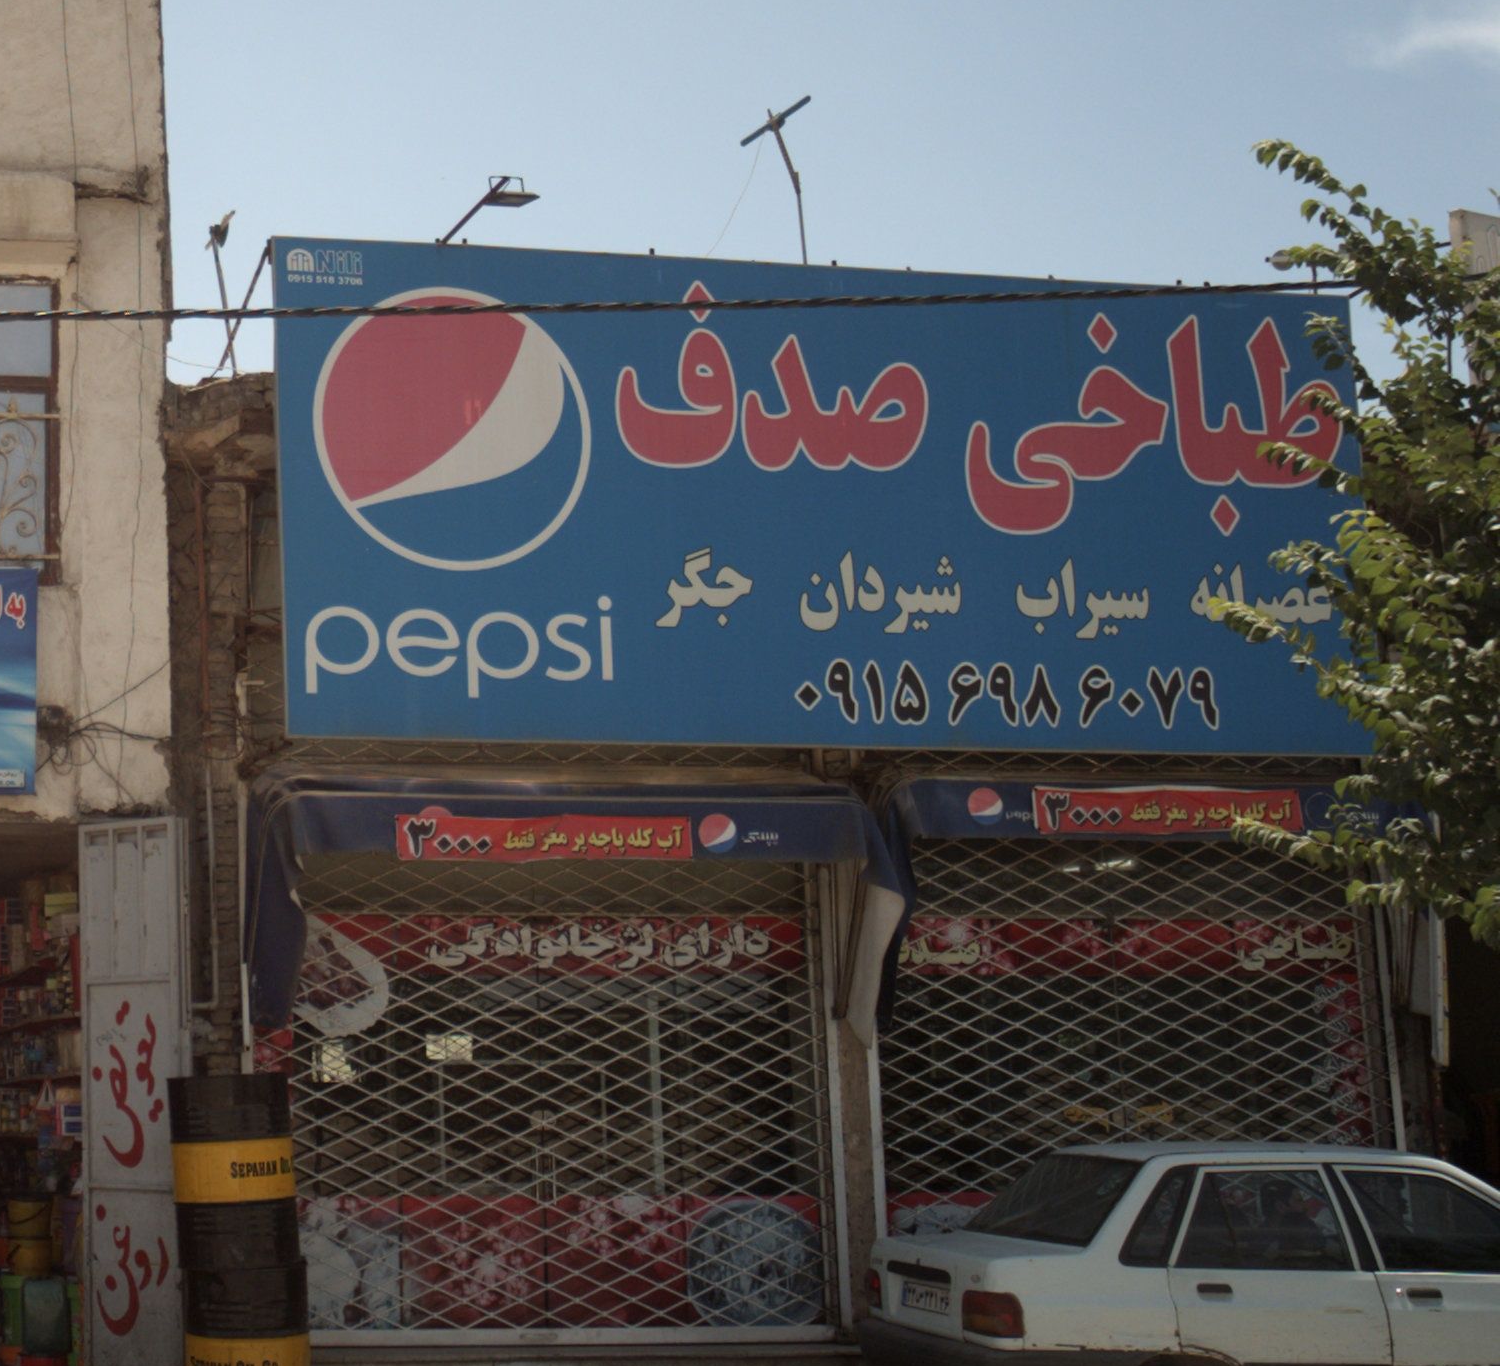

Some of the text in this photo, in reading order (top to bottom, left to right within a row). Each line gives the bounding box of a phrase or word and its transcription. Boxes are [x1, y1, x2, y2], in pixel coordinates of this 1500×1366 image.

[615, 279, 1345, 536] طباخی صدف
[5, 595, 27, 629] به
[654, 547, 753, 629] جگر
[799, 549, 962, 636] شیردان
[1015, 557, 1150, 640] سیراب
[304, 596, 614, 699] pepsi
[793, 657, 1220, 731] ۰۹۱۵ ۶۹۸ ۶۰۷۹
[1041, 791, 1123, 831] ۳۰۰۰
[1129, 800, 1162, 822] فقط
[1165, 802, 1189, 829] مغز
[1191, 807, 1206, 829] پر
[1268, 799, 1292, 822] آب
[404, 817, 684, 859] آب کله پاچه پر مغز فقط ۳۰۰۰
[425, 920, 617, 968] خانوادگی
[662, 920, 770, 968] دارای
[1236, 926, 1355, 972] طباخی
[92, 1000, 164, 1169] تعویض
[230, 1160, 277, 1179] SEPAHAN
[96, 1204, 170, 1337] روغن
